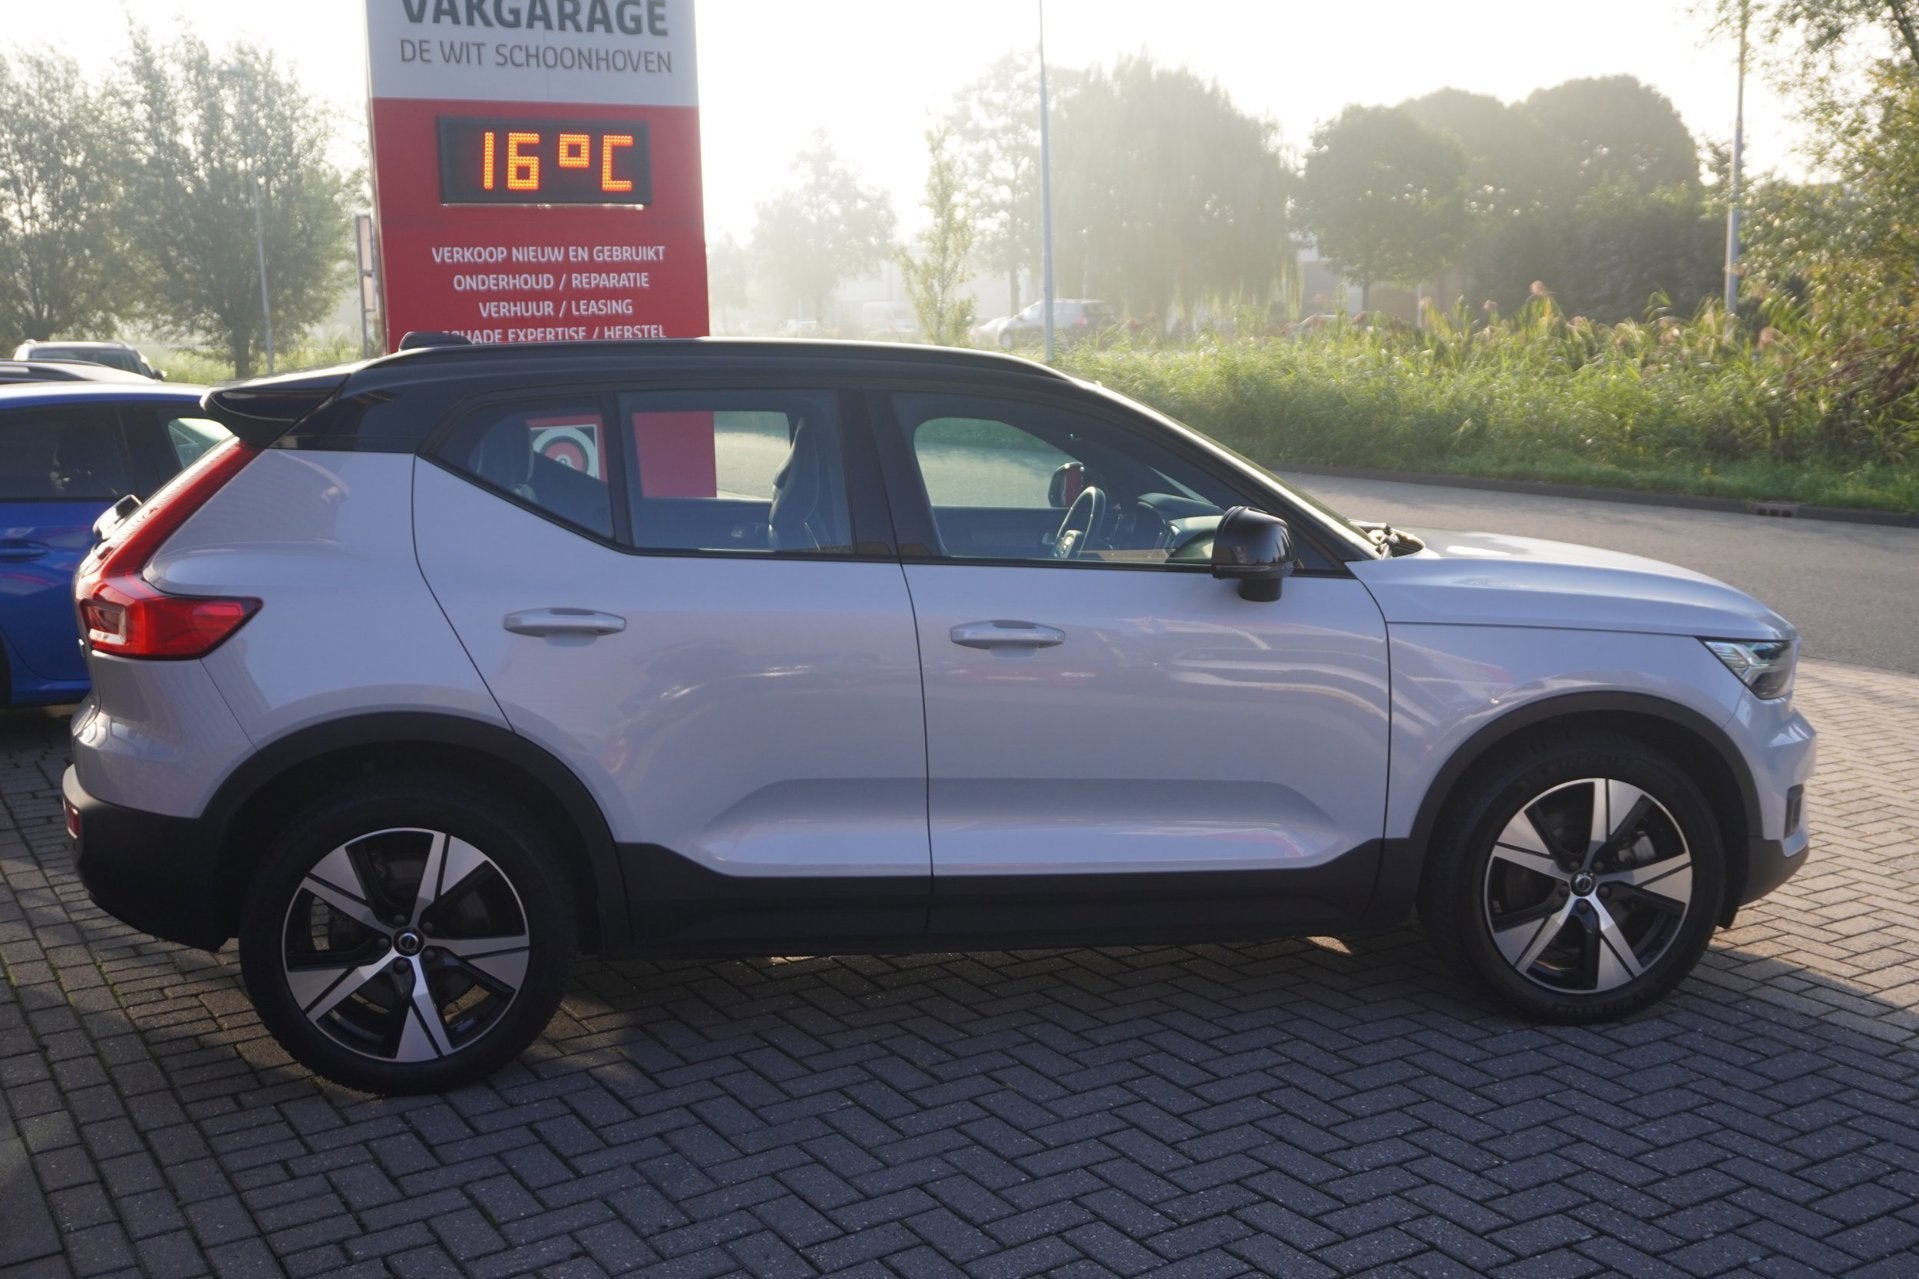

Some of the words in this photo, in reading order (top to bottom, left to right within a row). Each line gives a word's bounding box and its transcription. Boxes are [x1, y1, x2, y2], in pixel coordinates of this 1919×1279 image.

[402, 0, 669, 36] VAKGARAGE
[400, 39, 432, 63] DE
[439, 41, 486, 66] WIT
[495, 43, 673, 74] SCHOONHOVEN
[431, 246, 507, 263] VERKOOP
[512, 246, 564, 262] NIEUW
[568, 246, 588, 261] EN
[593, 245, 666, 261] GEBRUIKT
[453, 274, 554, 291] ONDERHOUD
[558, 273, 567, 291] /
[571, 272, 650, 288] REPARATIE
[478, 301, 554, 317] VERHUUR
[558, 300, 567, 318] /
[571, 299, 633, 315] LEASING
[441, 329, 503, 344] HADE
[507, 327, 586, 343] EXPERTISE
[592, 326, 600, 340] /
[604, 324, 667, 339] HERSTEL
